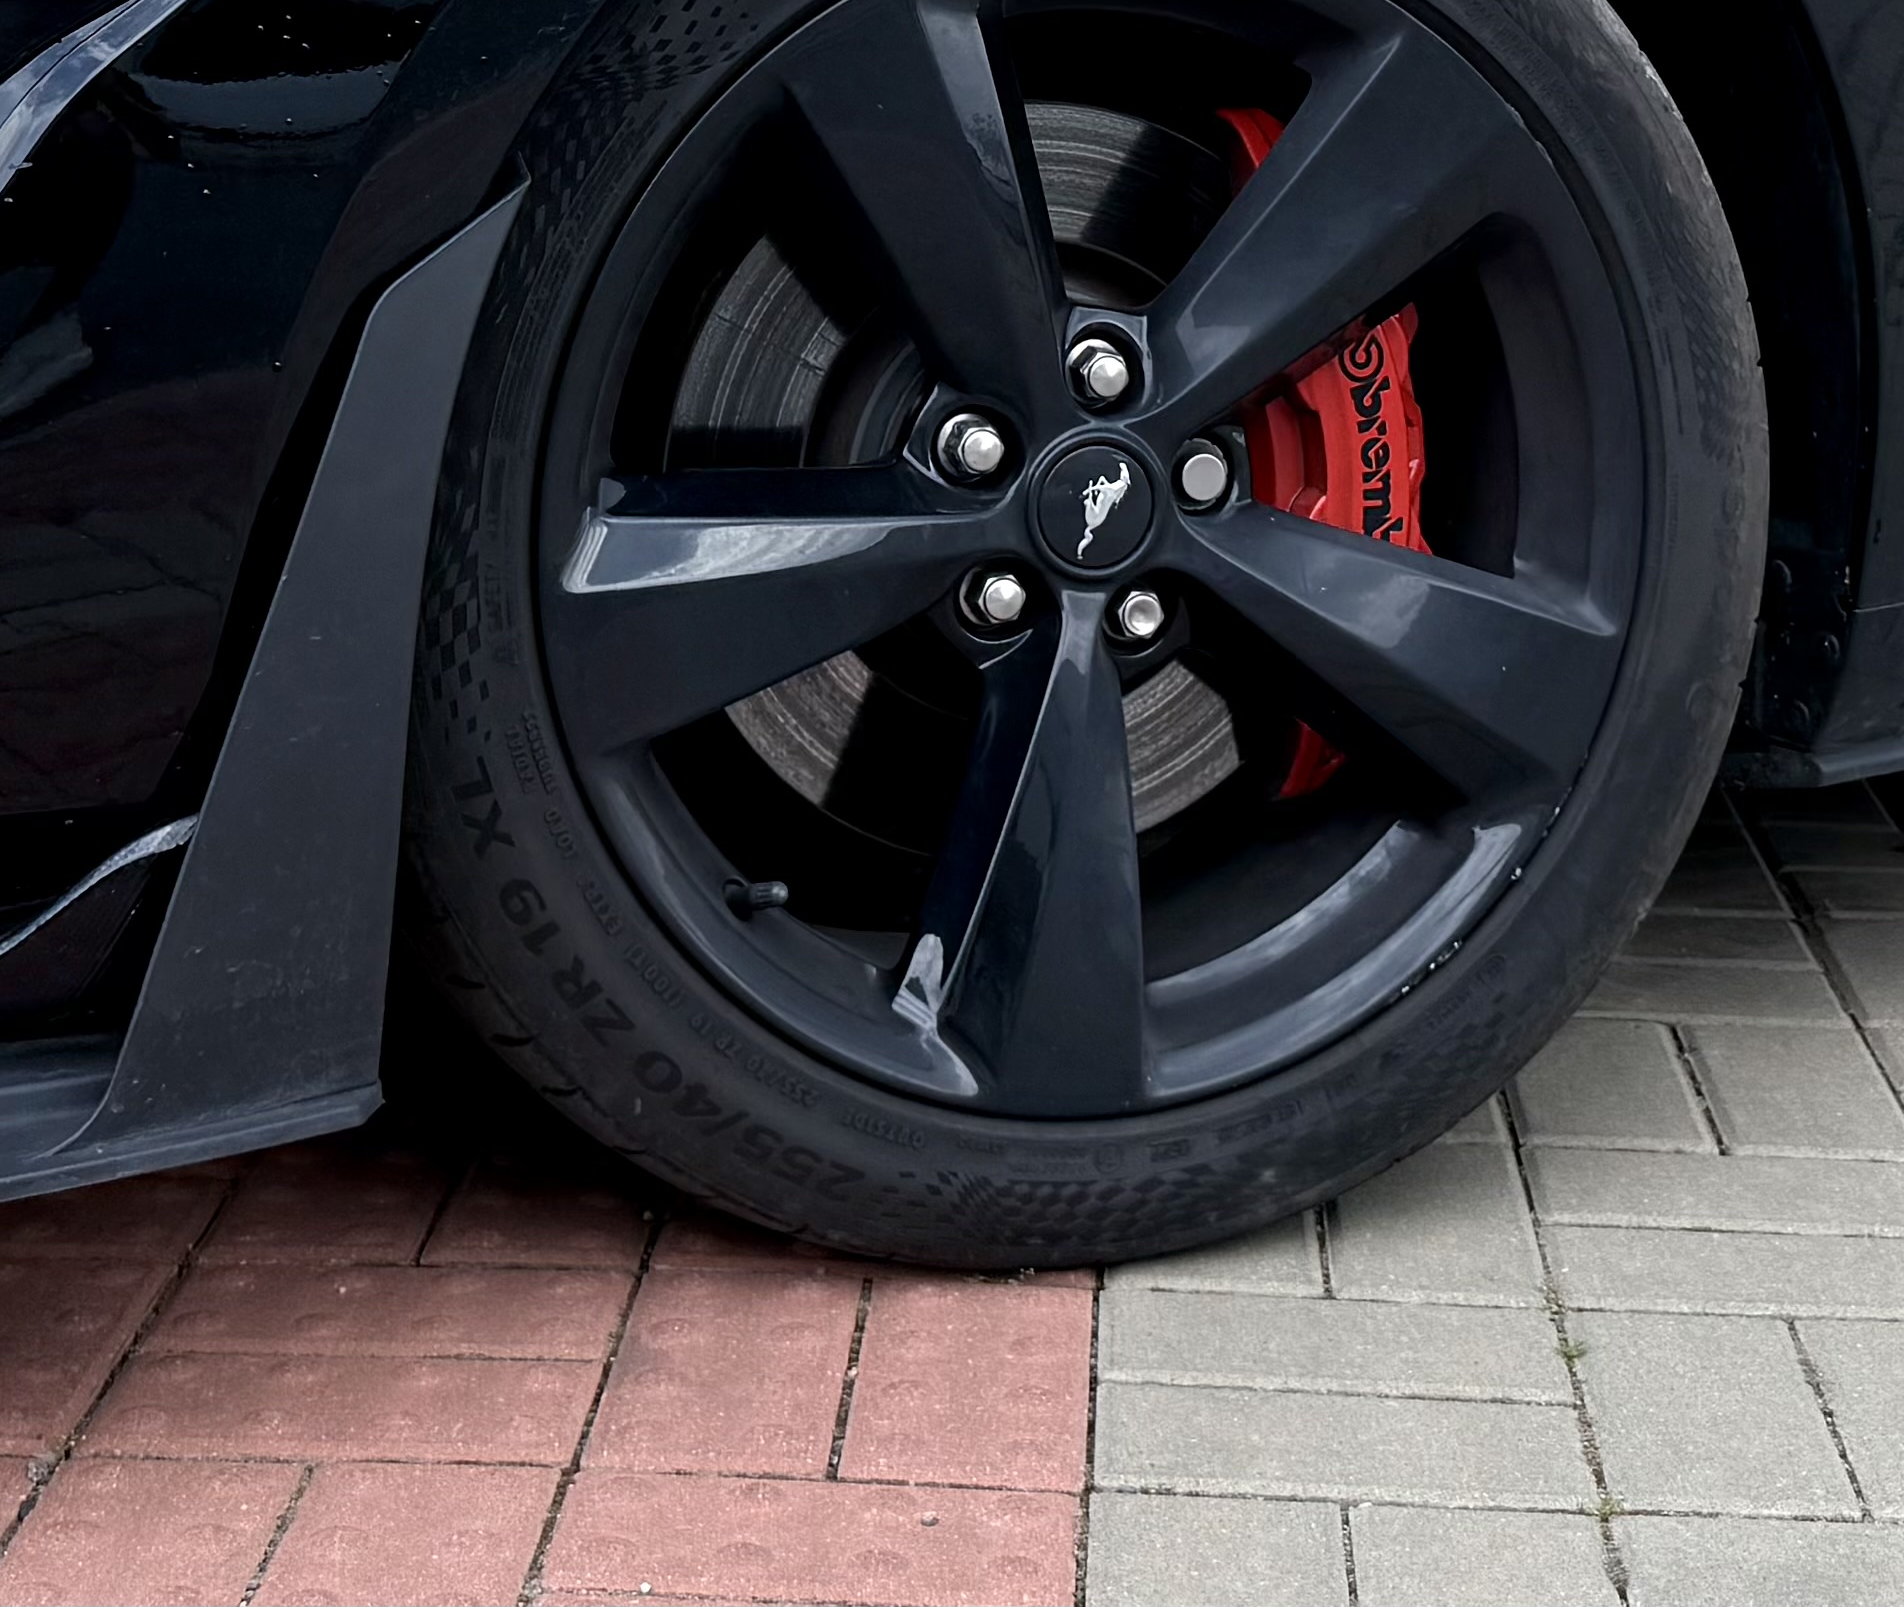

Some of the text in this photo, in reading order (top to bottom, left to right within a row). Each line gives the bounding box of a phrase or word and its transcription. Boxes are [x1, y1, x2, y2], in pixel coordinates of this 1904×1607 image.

[450, 755, 865, 1201] 255/40 ZR 19 XL
[689, 1010, 712, 1036] 19
[842, 1105, 927, 1150] OUTSIDE
